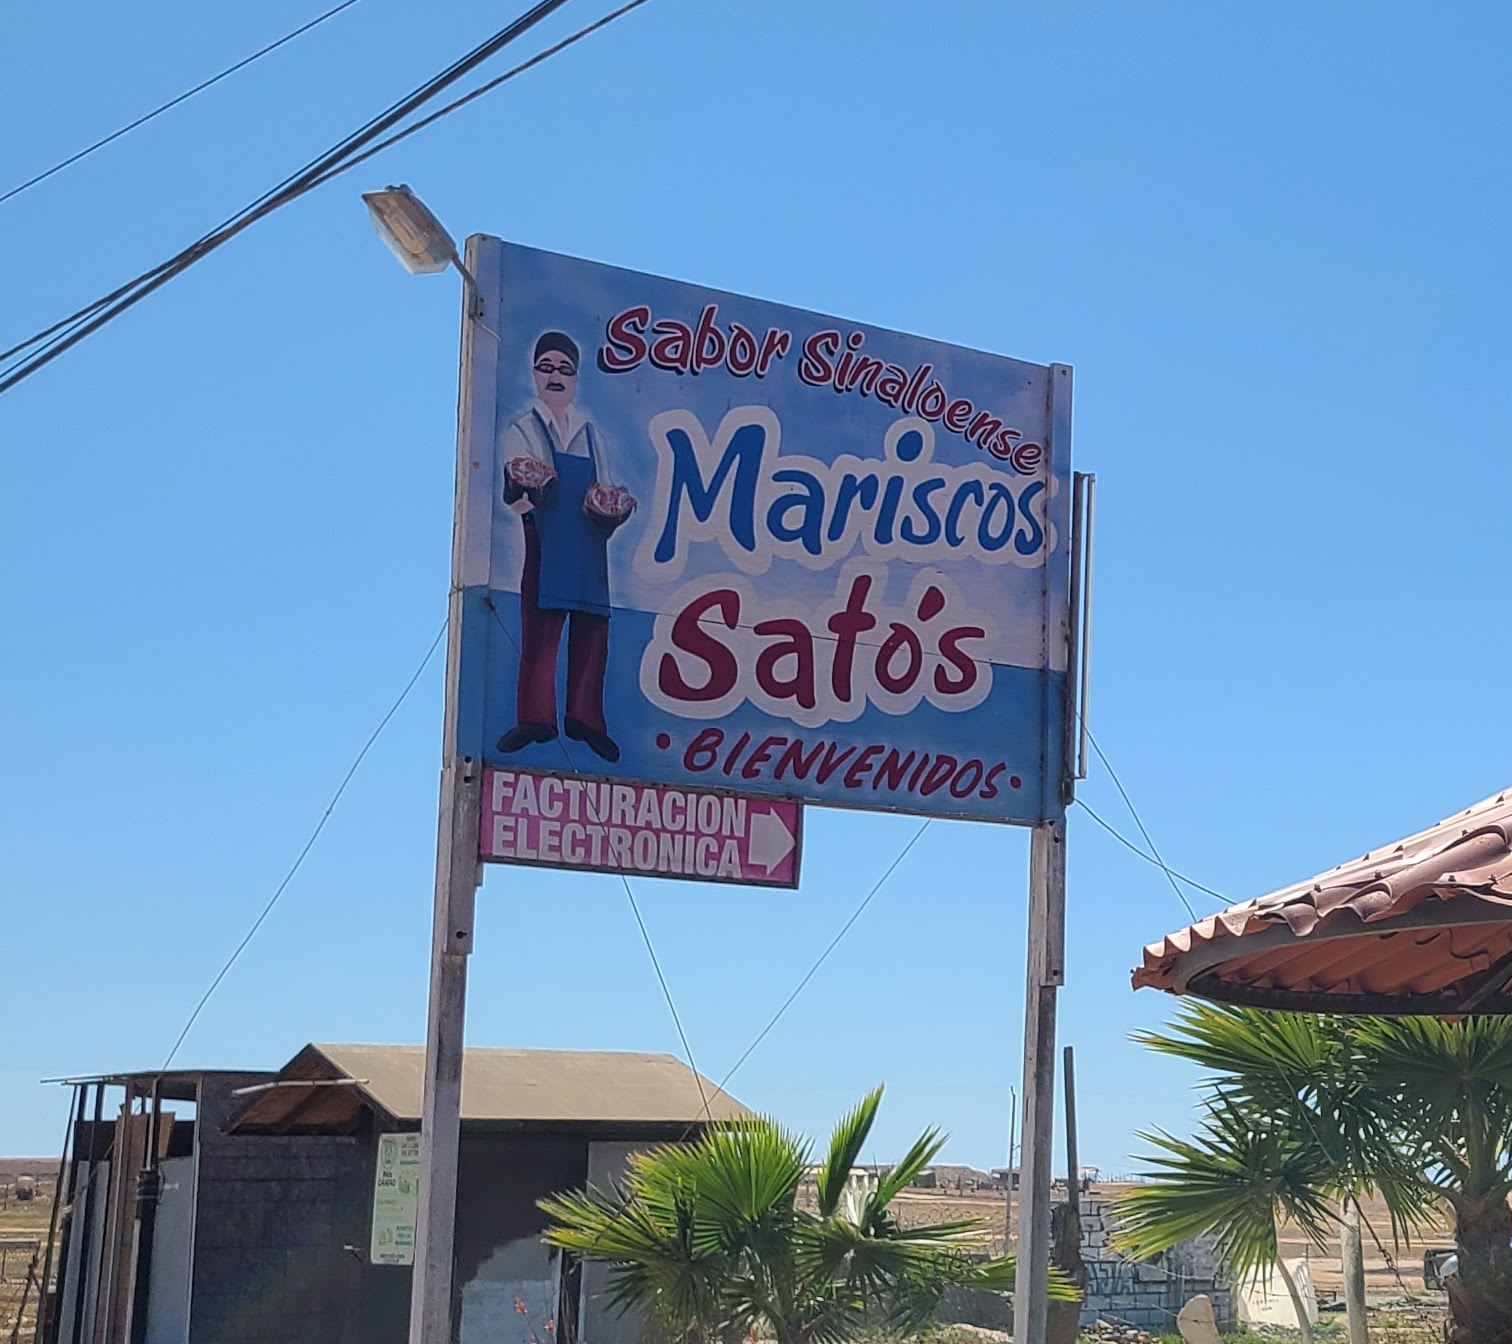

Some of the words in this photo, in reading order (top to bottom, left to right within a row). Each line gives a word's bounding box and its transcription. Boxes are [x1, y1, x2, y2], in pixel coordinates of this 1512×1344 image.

[599, 304, 792, 378] Sabor
[798, 330, 1047, 476] Sinaloense
[653, 423, 1046, 564] Mariscos
[683, 727, 1007, 800] BIENVENIDOS
[491, 770, 747, 839] FACTURACION
[491, 814, 744, 879] ELECTRONICA
